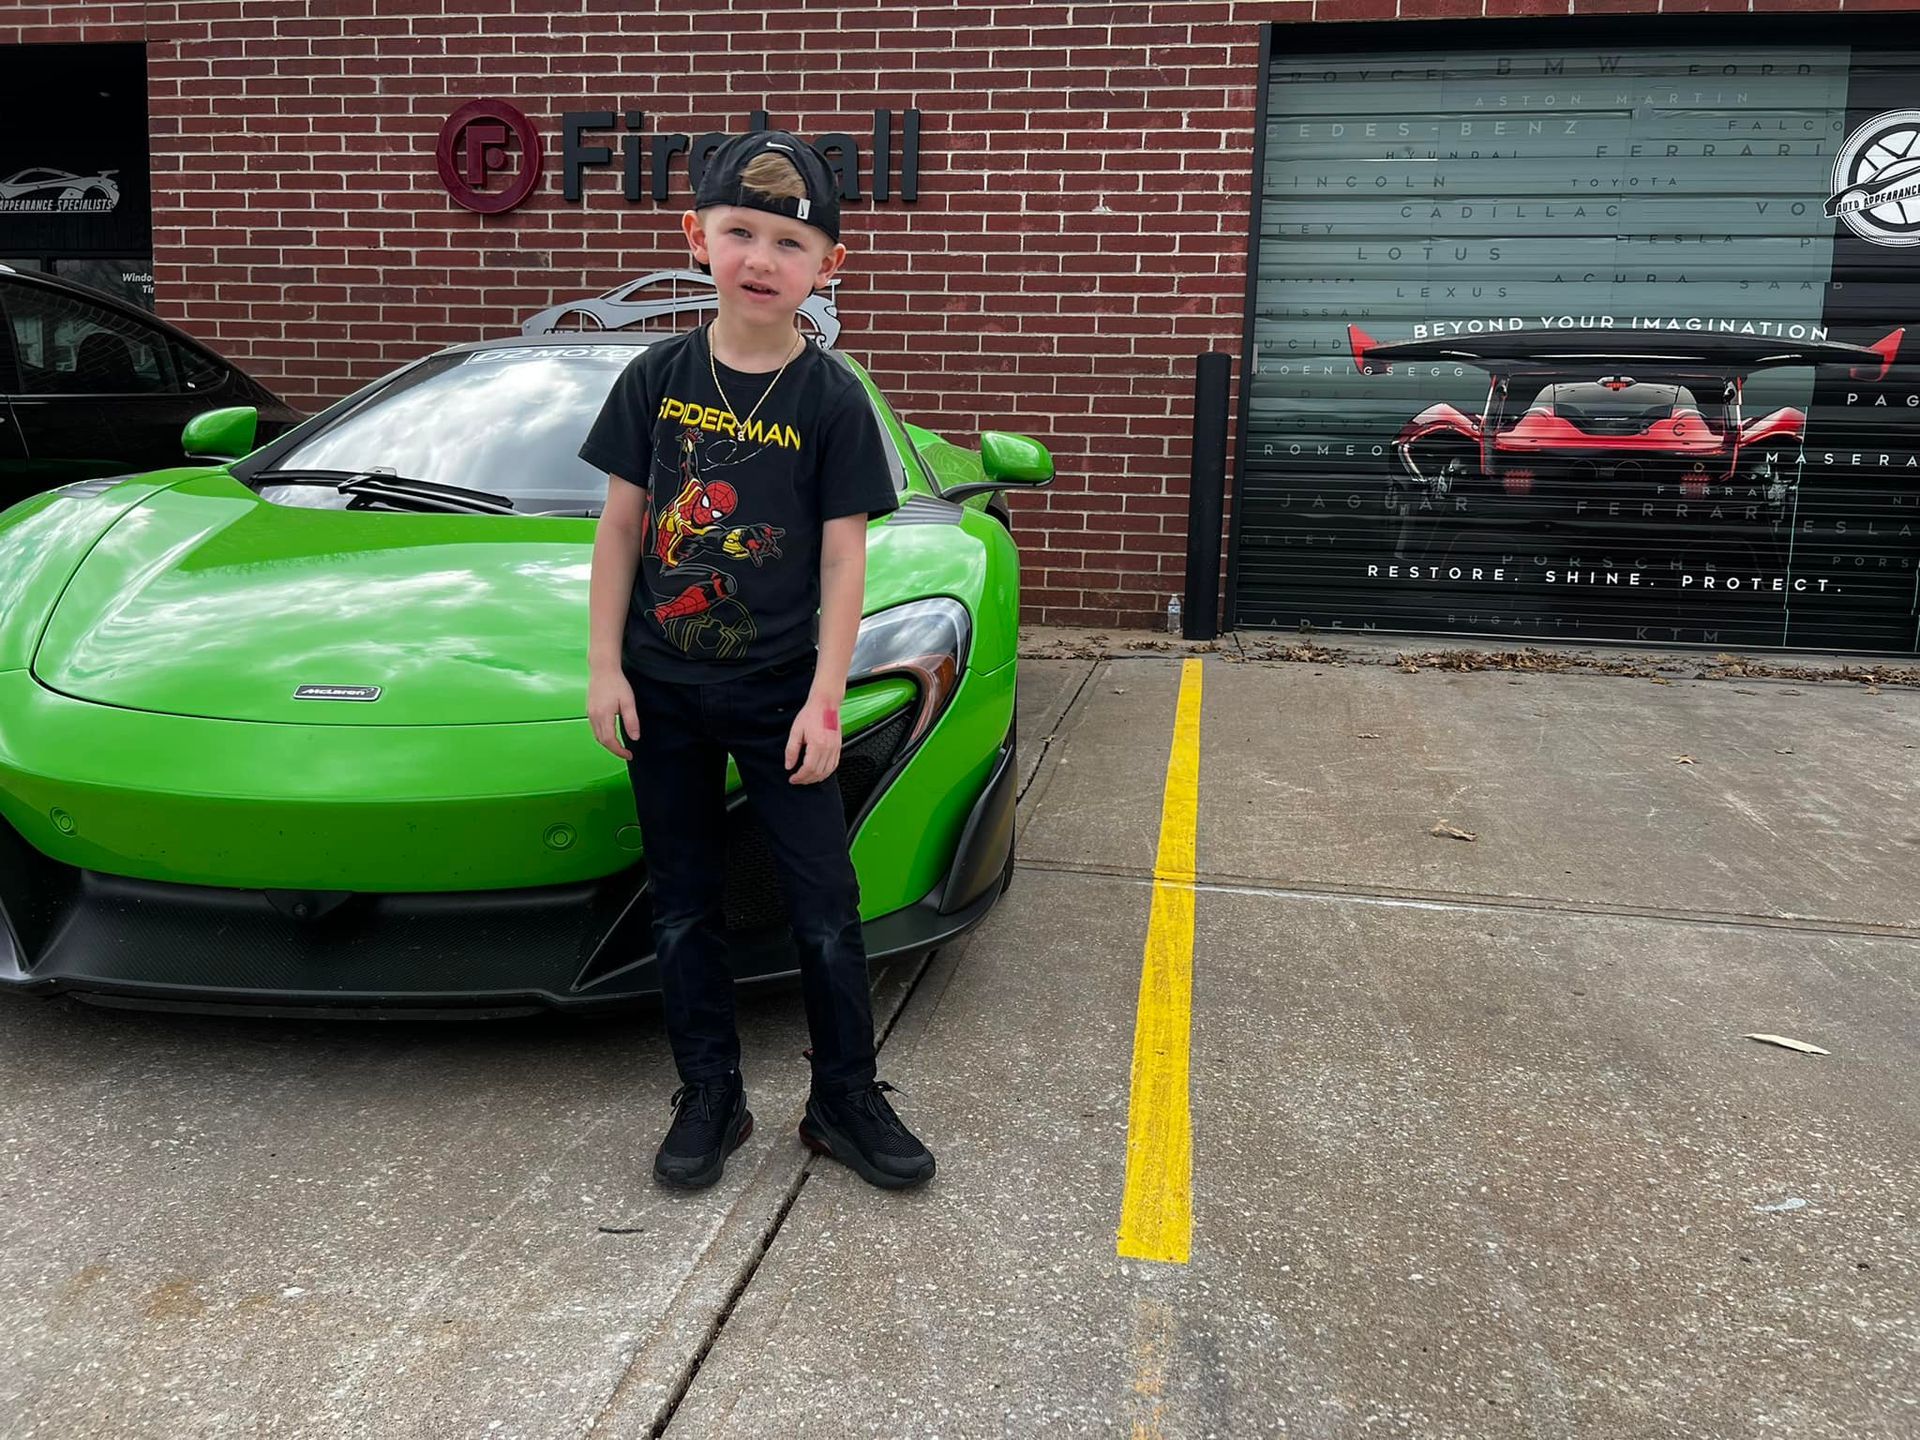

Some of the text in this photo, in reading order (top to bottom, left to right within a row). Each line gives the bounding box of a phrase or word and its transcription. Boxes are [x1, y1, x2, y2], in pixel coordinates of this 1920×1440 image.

[1475, 92, 1748, 106] ASTON MARTIN
[1728, 119, 1843, 131] FALCO
[1386, 150, 1518, 160] HYUNDAI
[1596, 144, 1820, 158] FERRARI
[1267, 175, 1445, 188] LINCOLN
[1571, 177, 1677, 187] TOYOTA
[57, 198, 113, 212] SPECIALISTS
[1837, 184, 1920, 213] AUTO APPEARANC
[1401, 205, 1618, 218] CADILLAC
[1358, 247, 1501, 261] LOTUS
[1553, 273, 1688, 283] ACURA
[1396, 287, 1507, 298] LEXUS
[1739, 281, 1843, 290] SAAB
[1265, 308, 1370, 318] NISSAN
[1414, 315, 1829, 341] BEYOND YOUR IMAGINATION
[1260, 366, 1464, 377] KOENIGSEGG
[1846, 393, 1920, 407] PAG
[1263, 444, 1383, 456] ROMEO
[1766, 451, 1918, 467] MASERA
[1280, 494, 1468, 511] JAGUAR
[1576, 501, 1785, 520] FERRARI
[1771, 519, 1912, 537] TESLA
[1832, 556, 1909, 568] PORS
[1368, 565, 1842, 593] RESTORE. SHINE. PROTECT.
[1448, 614, 1580, 628] BUGATTI
[1636, 627, 1719, 643] KTM
